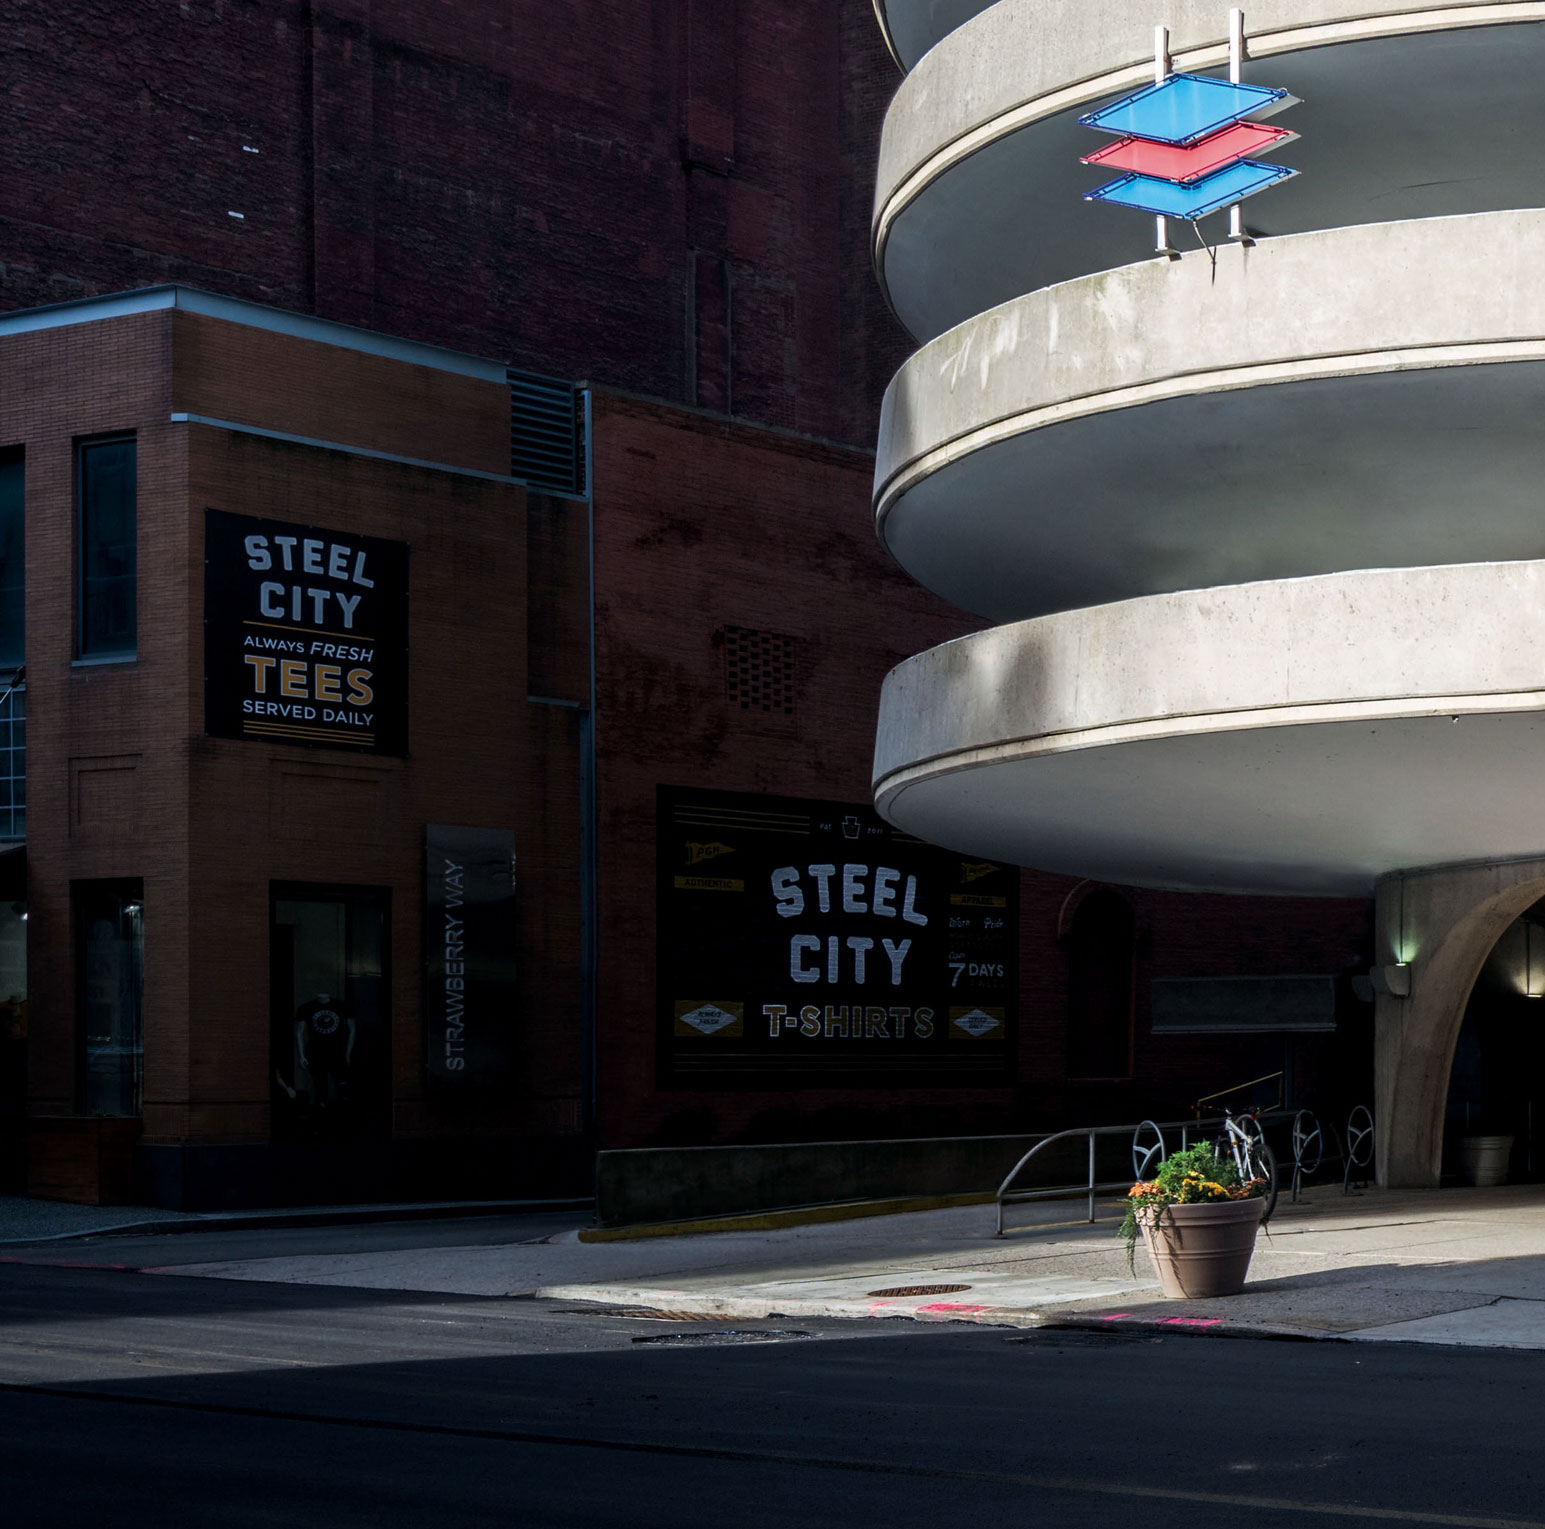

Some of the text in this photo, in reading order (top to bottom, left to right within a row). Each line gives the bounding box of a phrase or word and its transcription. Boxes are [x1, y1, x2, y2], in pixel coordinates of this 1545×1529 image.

[244, 534, 375, 589] STEEL
[260, 581, 361, 629] CITY
[244, 636, 374, 663] ALWAYS FRESH
[244, 654, 374, 706] TEES
[243, 699, 374, 726] SERVED DAILY
[684, 878, 733, 889] AUTHENTIC
[770, 863, 929, 927] STEEL
[445, 858, 465, 1071] STRAWBERRY WAY
[790, 933, 912, 985] CITY
[948, 962, 966, 987] 7
[968, 963, 1004, 978] DAYS
[762, 1004, 934, 1039] T-SHIRTS
